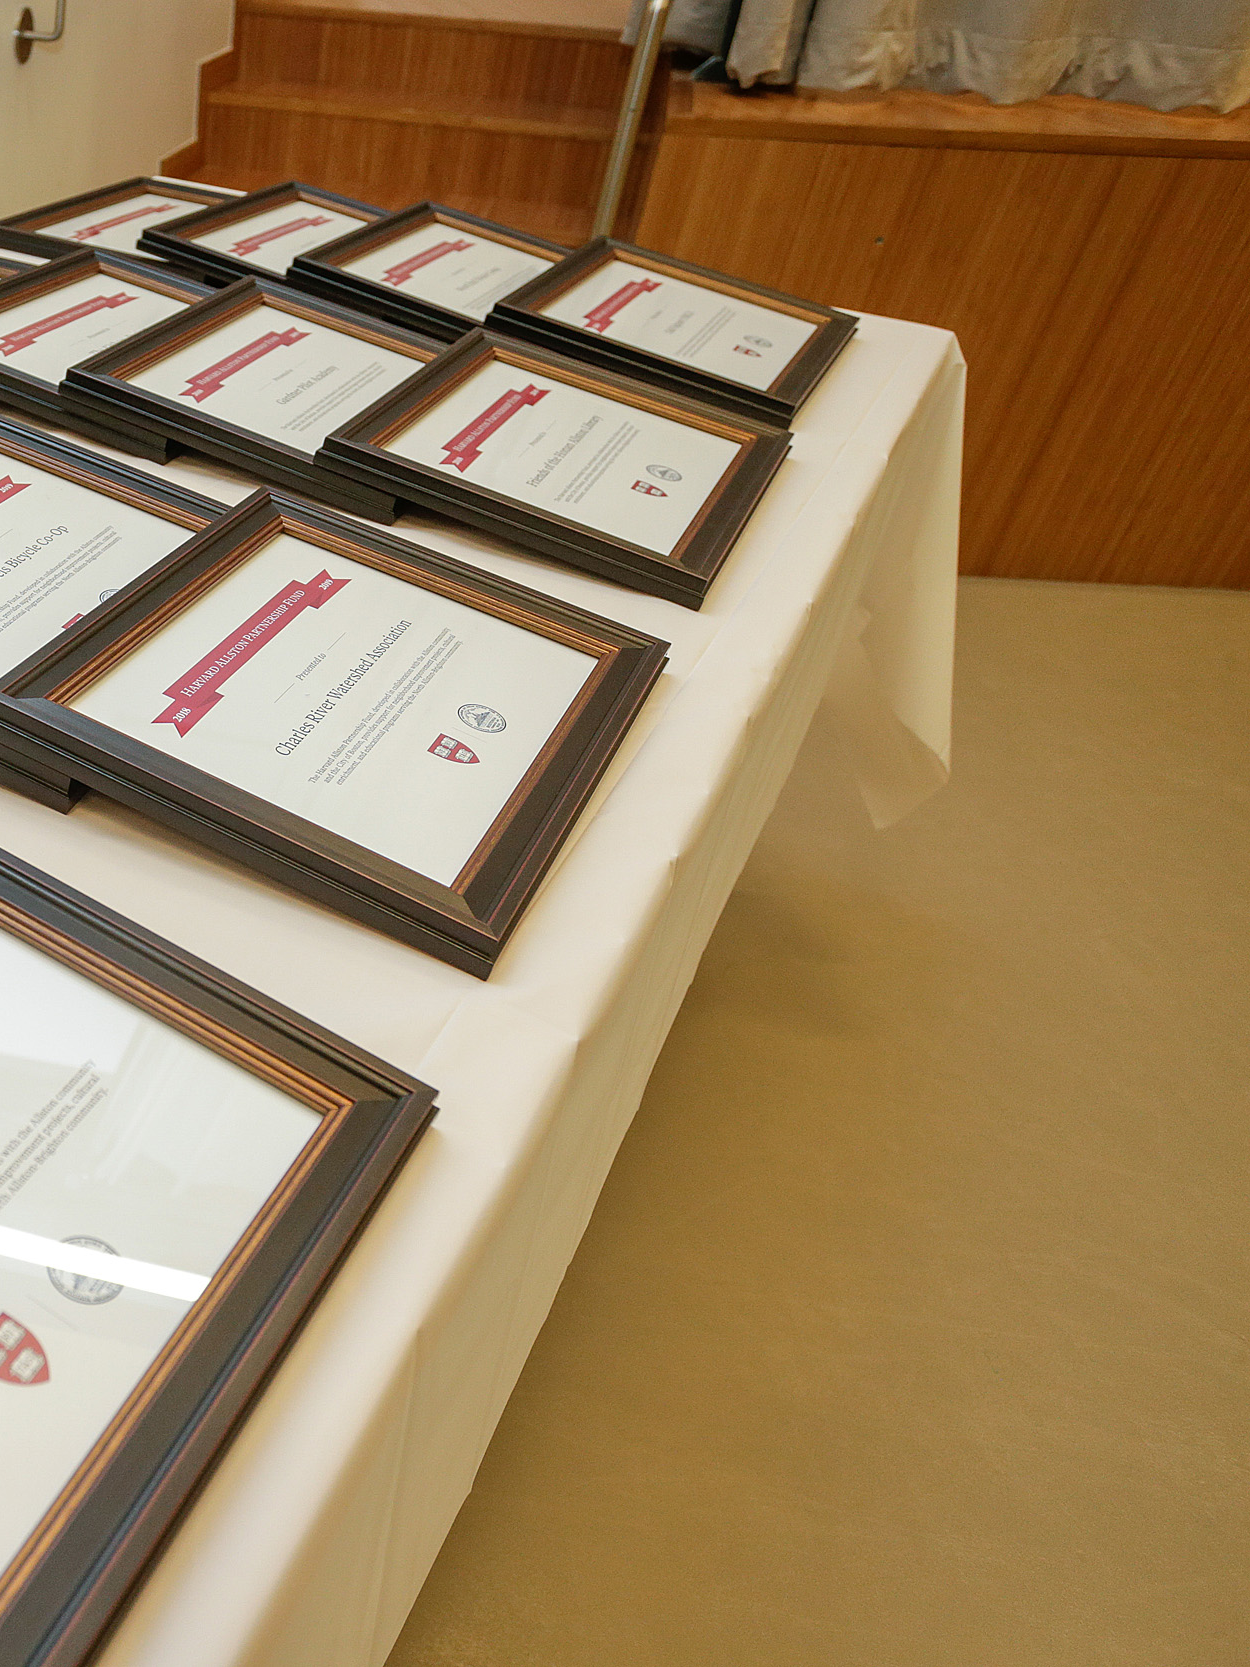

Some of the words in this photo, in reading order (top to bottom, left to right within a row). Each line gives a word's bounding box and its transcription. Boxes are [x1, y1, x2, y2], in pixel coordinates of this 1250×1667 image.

[526, 469, 550, 487] Friends
[547, 457, 562, 465] the
[4, 545, 41, 567] Bicycle
[35, 525, 69, 545] Co-Op
[317, 578, 334, 590] 2019
[179, 666, 220, 696] HARVARD
[213, 640, 249, 667] ALLSTON
[242, 605, 289, 641] PARTNERSHIP
[282, 590, 306, 606] FUND
[294, 656, 322, 680] Presented
[274, 723, 315, 756] Charles
[305, 699, 336, 723] River
[327, 658, 374, 698] Watershed
[365, 620, 412, 661] Association
[171, 707, 191, 722] 2018
[72, 1073, 100, 1103] cultural
[2, 1140, 20, 1156] with
[16, 1127, 33, 1140] the
[30, 1101, 58, 1127] Allston
[56, 1060, 97, 1100] community
